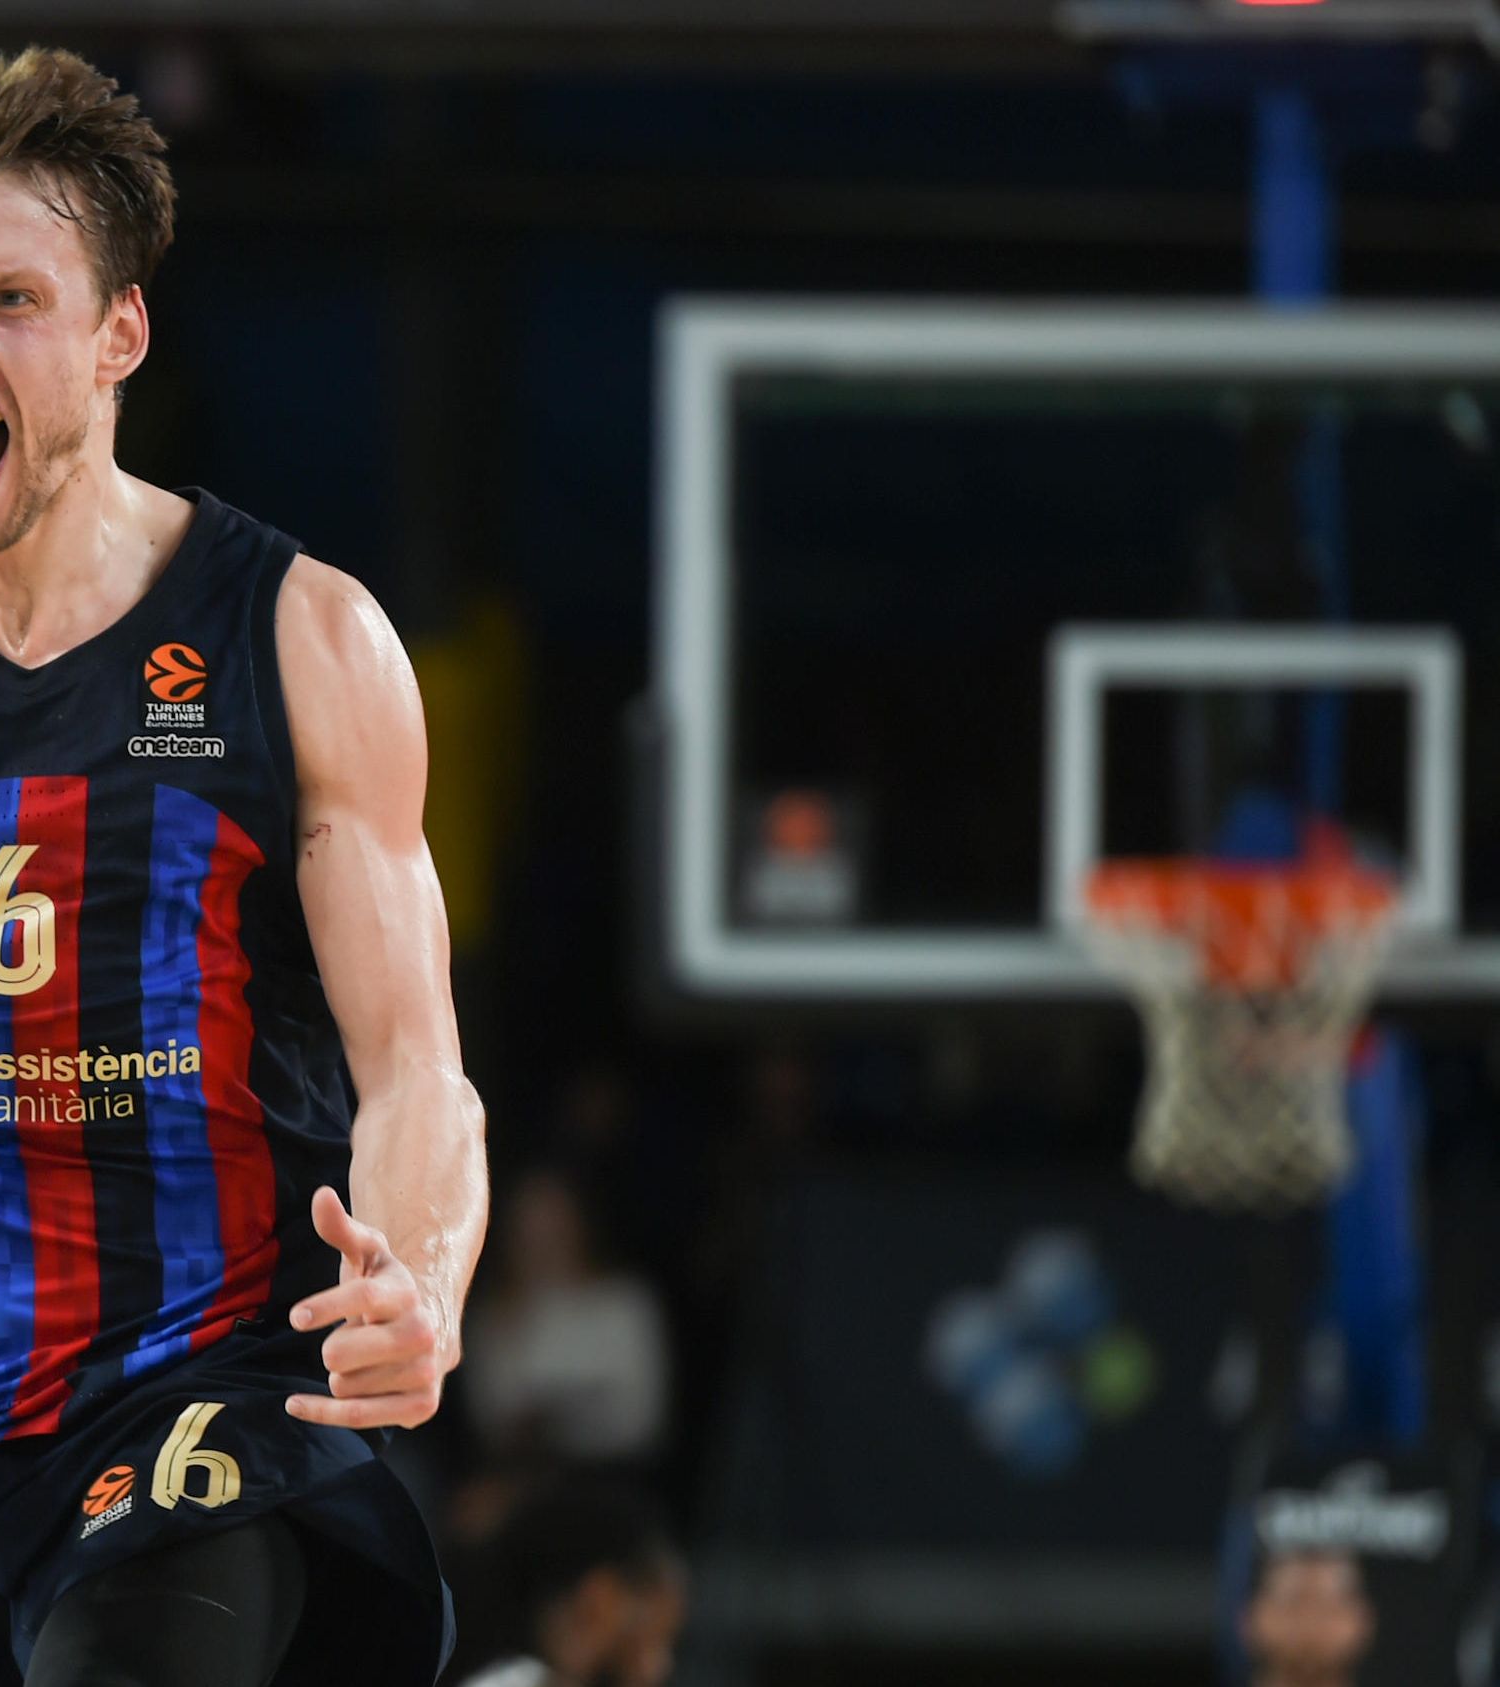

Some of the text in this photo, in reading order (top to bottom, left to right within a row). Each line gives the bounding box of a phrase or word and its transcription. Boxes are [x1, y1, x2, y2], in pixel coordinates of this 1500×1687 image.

[146, 703, 205, 713] TURKISH
[146, 713, 205, 721] AIRLINES
[129, 734, 224, 757] oneteam
[150, 1402, 241, 1510] 6
